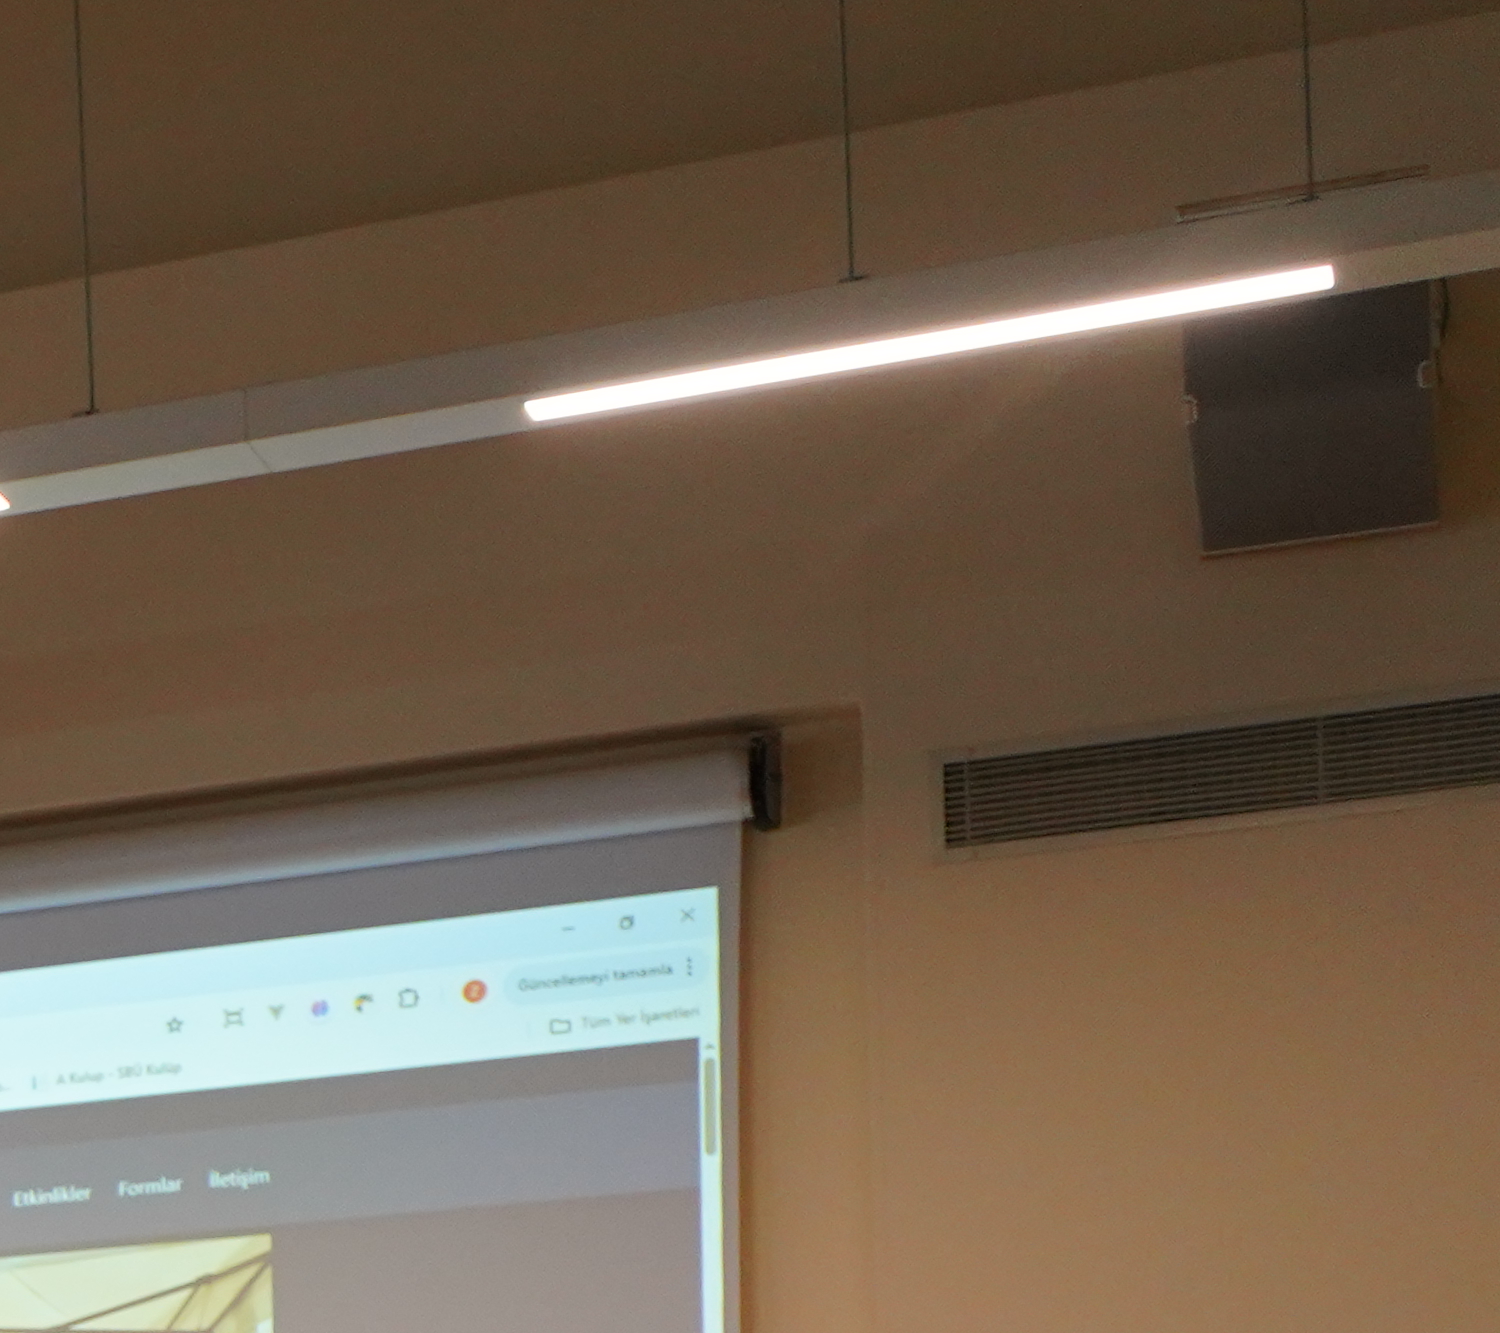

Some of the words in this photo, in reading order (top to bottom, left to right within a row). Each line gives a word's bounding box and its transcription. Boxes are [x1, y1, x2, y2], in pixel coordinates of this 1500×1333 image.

[118, 1177, 182, 1197] Formlar
[208, 1169, 270, 1190] İletişim
[12, 1186, 91, 1207] Etkinlikler
